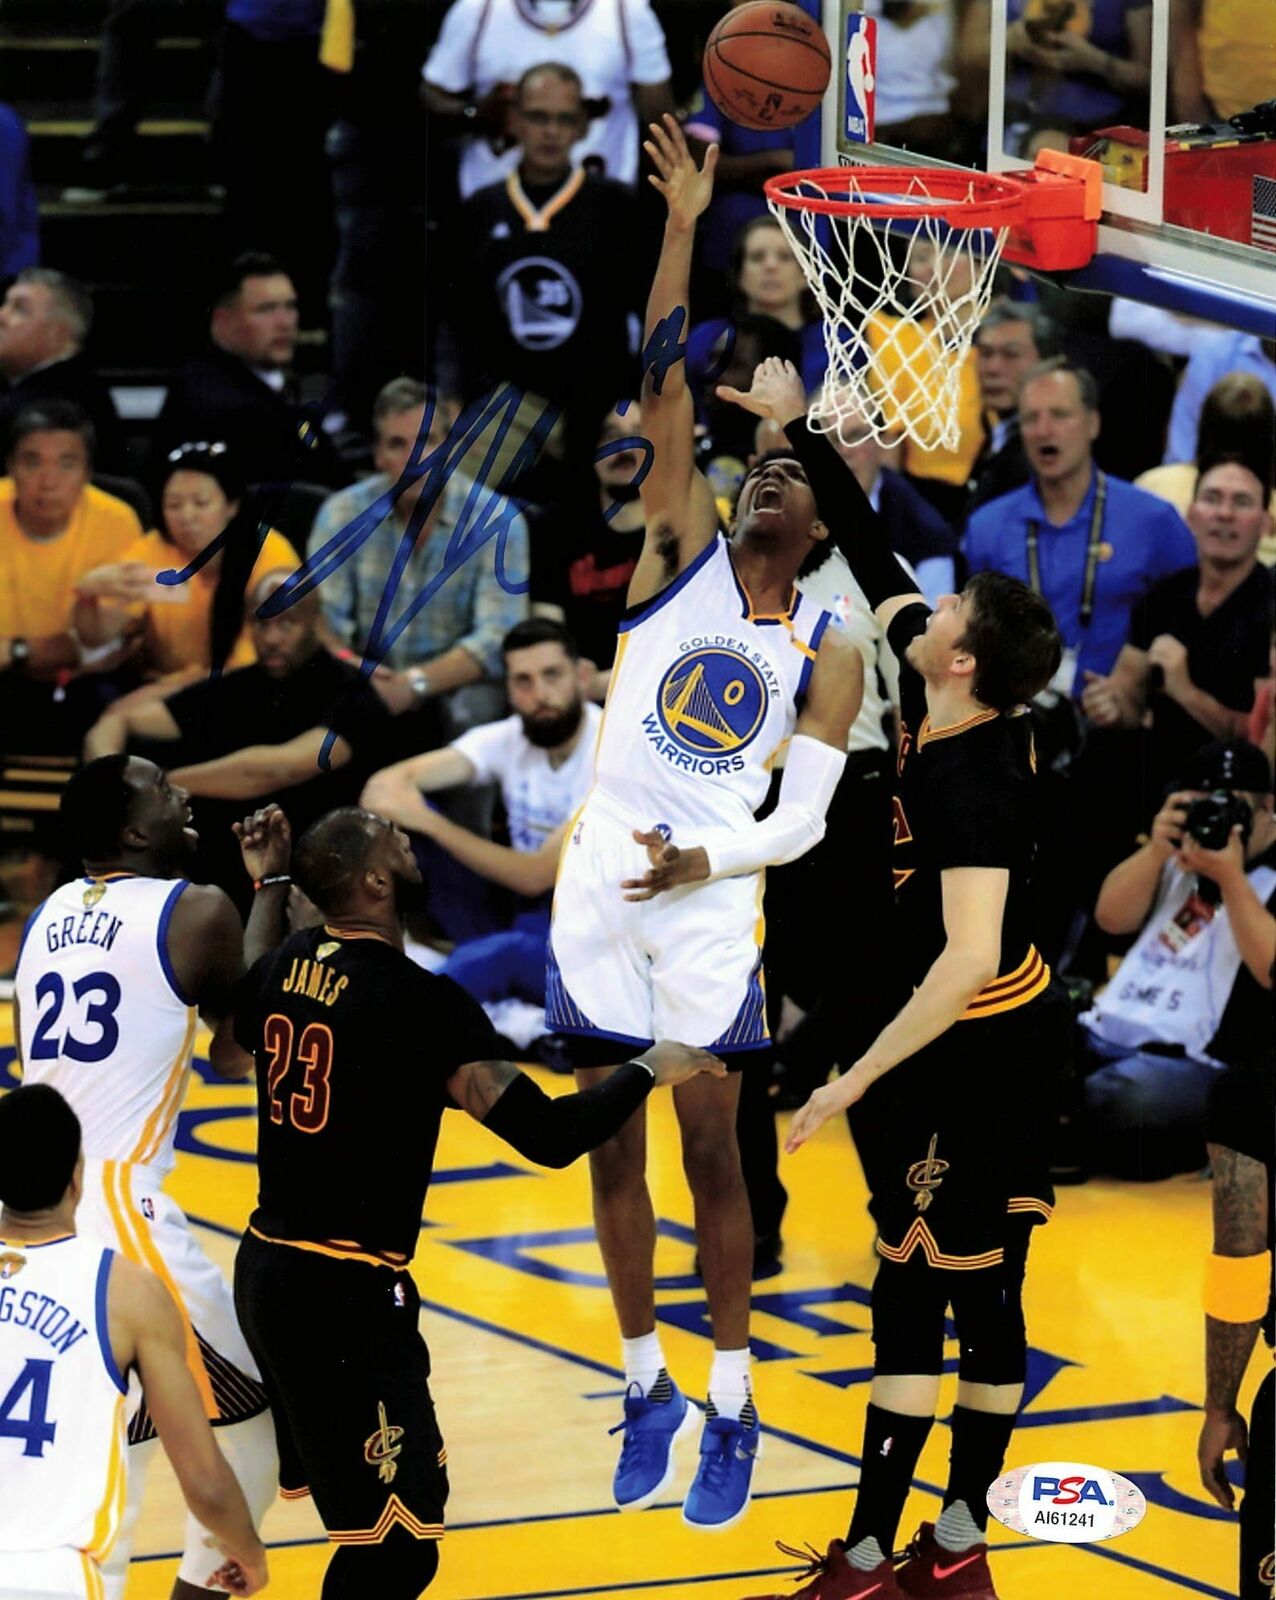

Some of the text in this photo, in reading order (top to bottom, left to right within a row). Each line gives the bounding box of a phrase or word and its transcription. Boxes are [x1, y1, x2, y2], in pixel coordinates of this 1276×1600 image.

[679, 635, 781, 699] GOLDEN STATE
[723, 678, 746, 706] 0
[641, 712, 745, 776] WARRIORS
[46, 911, 124, 953] GREEN
[282, 957, 349, 1006] JAMES
[30, 971, 122, 1064] 23
[264, 1013, 334, 1134] 23
